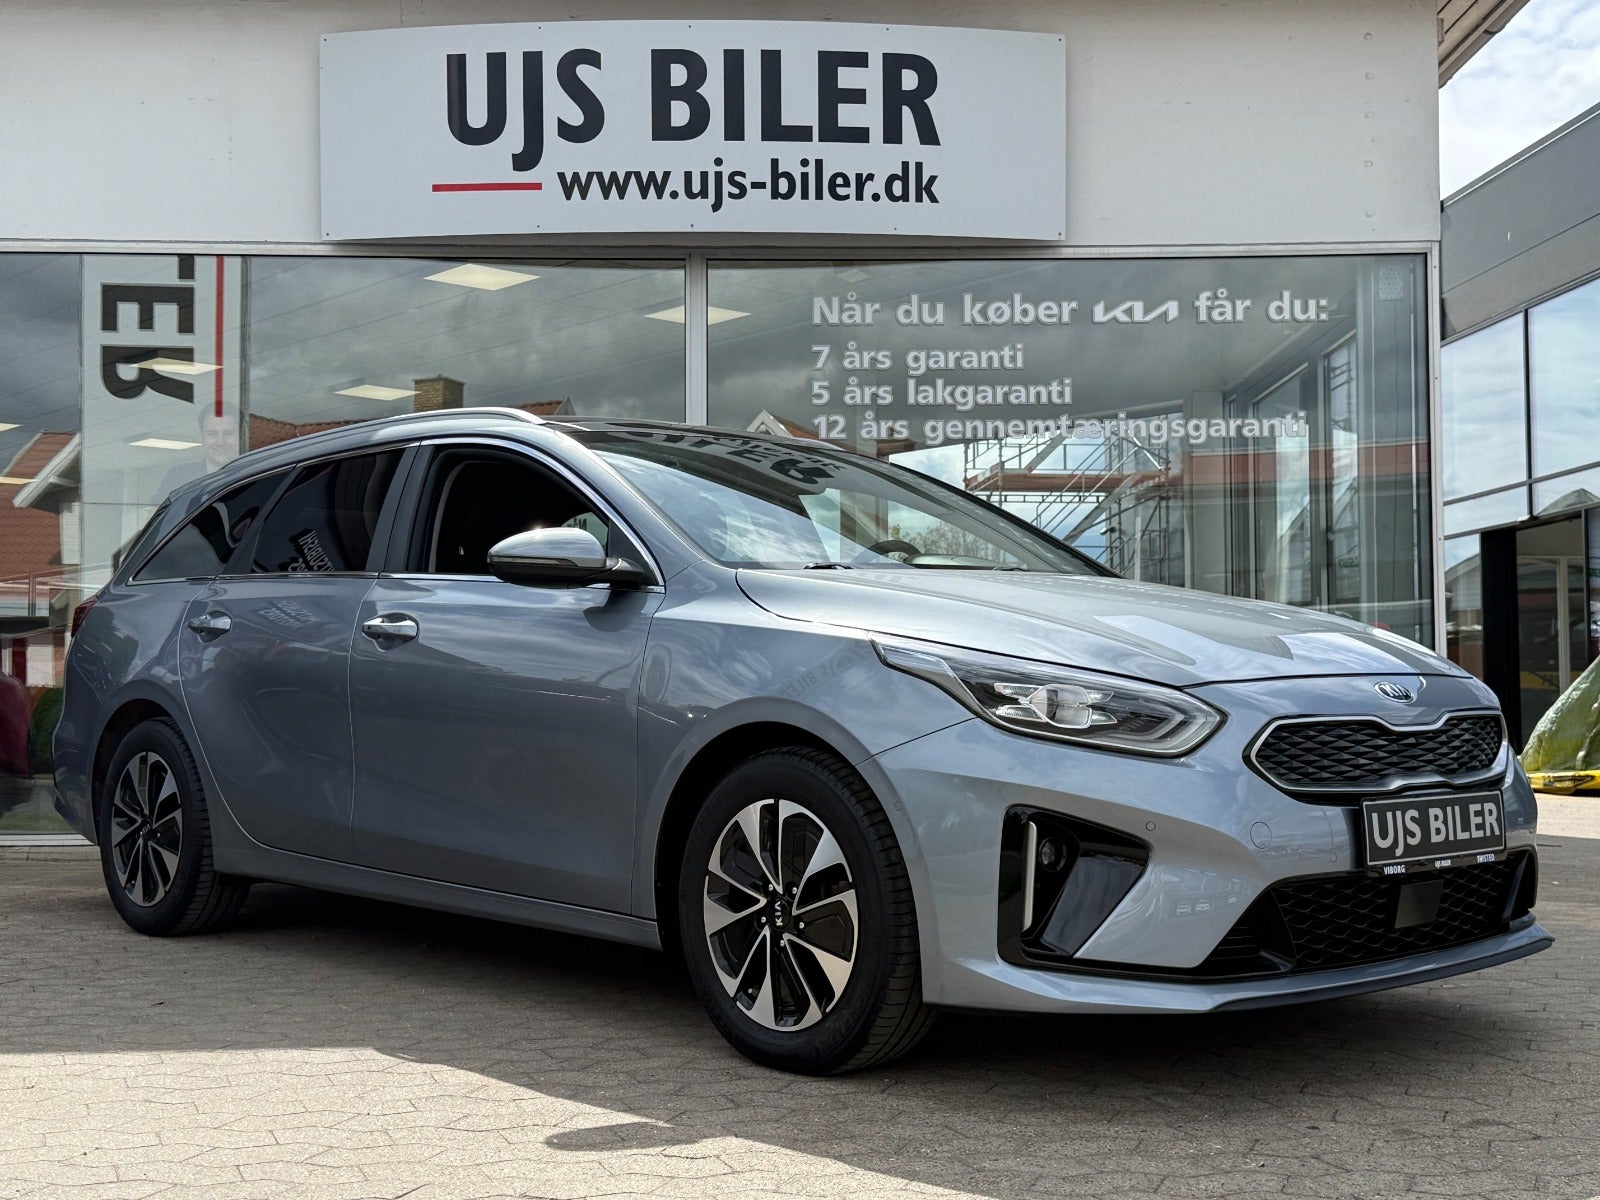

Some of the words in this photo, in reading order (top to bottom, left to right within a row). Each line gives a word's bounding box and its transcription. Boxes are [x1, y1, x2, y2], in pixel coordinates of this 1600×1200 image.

[446, 48, 605, 172] UJS
[650, 48, 941, 146] BILER
[556, 157, 939, 213] www.ujs-biler.dk
[811, 291, 880, 325] Når
[896, 293, 945, 325] du
[962, 292, 1078, 326] køber
[1193, 288, 1250, 324] får
[1265, 289, 1329, 324] du:
[811, 345, 831, 370] 7
[842, 341, 893, 370] års
[905, 343, 1025, 376] garanti
[811, 379, 831, 406] 5
[842, 376, 894, 406] års
[906, 377, 1073, 411] lakgaranti
[811, 413, 847, 439] 12
[860, 410, 910, 440] års
[923, 410, 1308, 446] gennemtæringsgaranti
[1371, 808, 1422, 857] UJS
[1428, 802, 1501, 844] BILER
[1383, 865, 1406, 875] VIBORG
